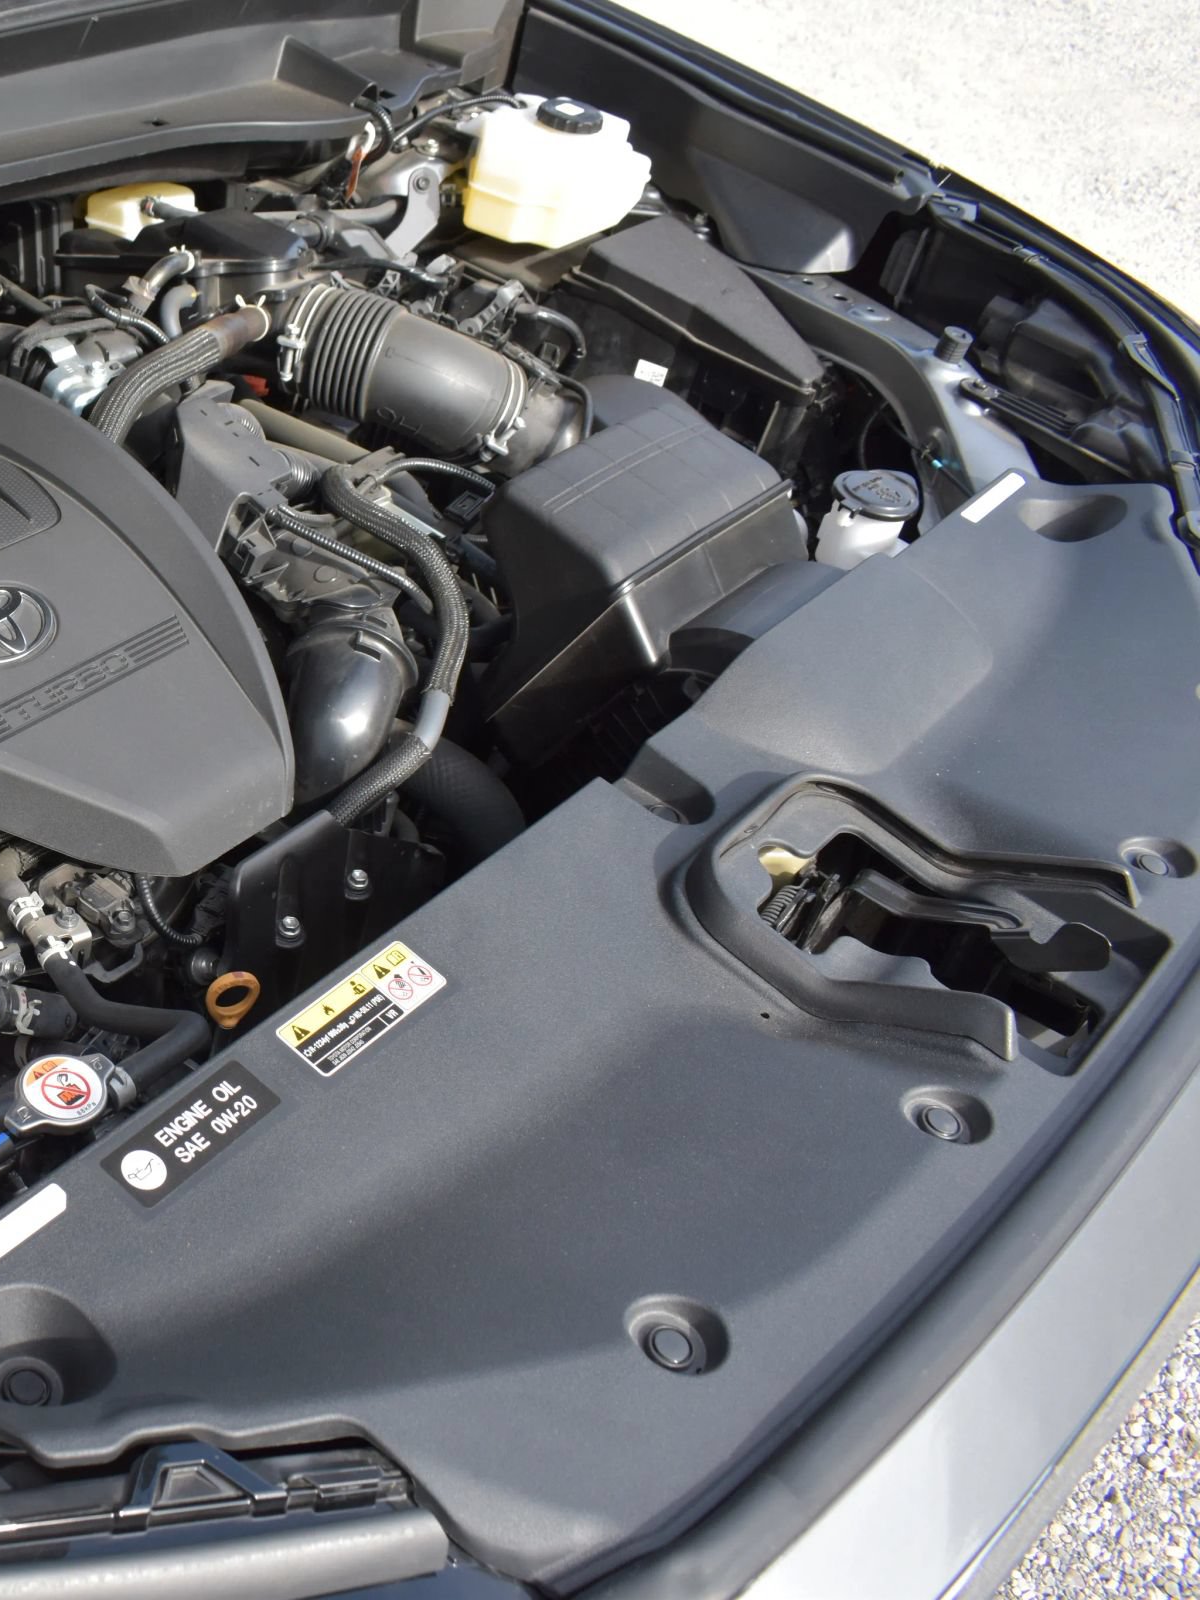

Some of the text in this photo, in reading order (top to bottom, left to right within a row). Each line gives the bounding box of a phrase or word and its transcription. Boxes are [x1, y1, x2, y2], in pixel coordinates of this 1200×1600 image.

[3, 652, 129, 720] TURBO
[385, 1009, 399, 1020] VR
[154, 1080, 242, 1147] ENGINE OIL
[174, 1095, 258, 1163] SAE 0W-20
